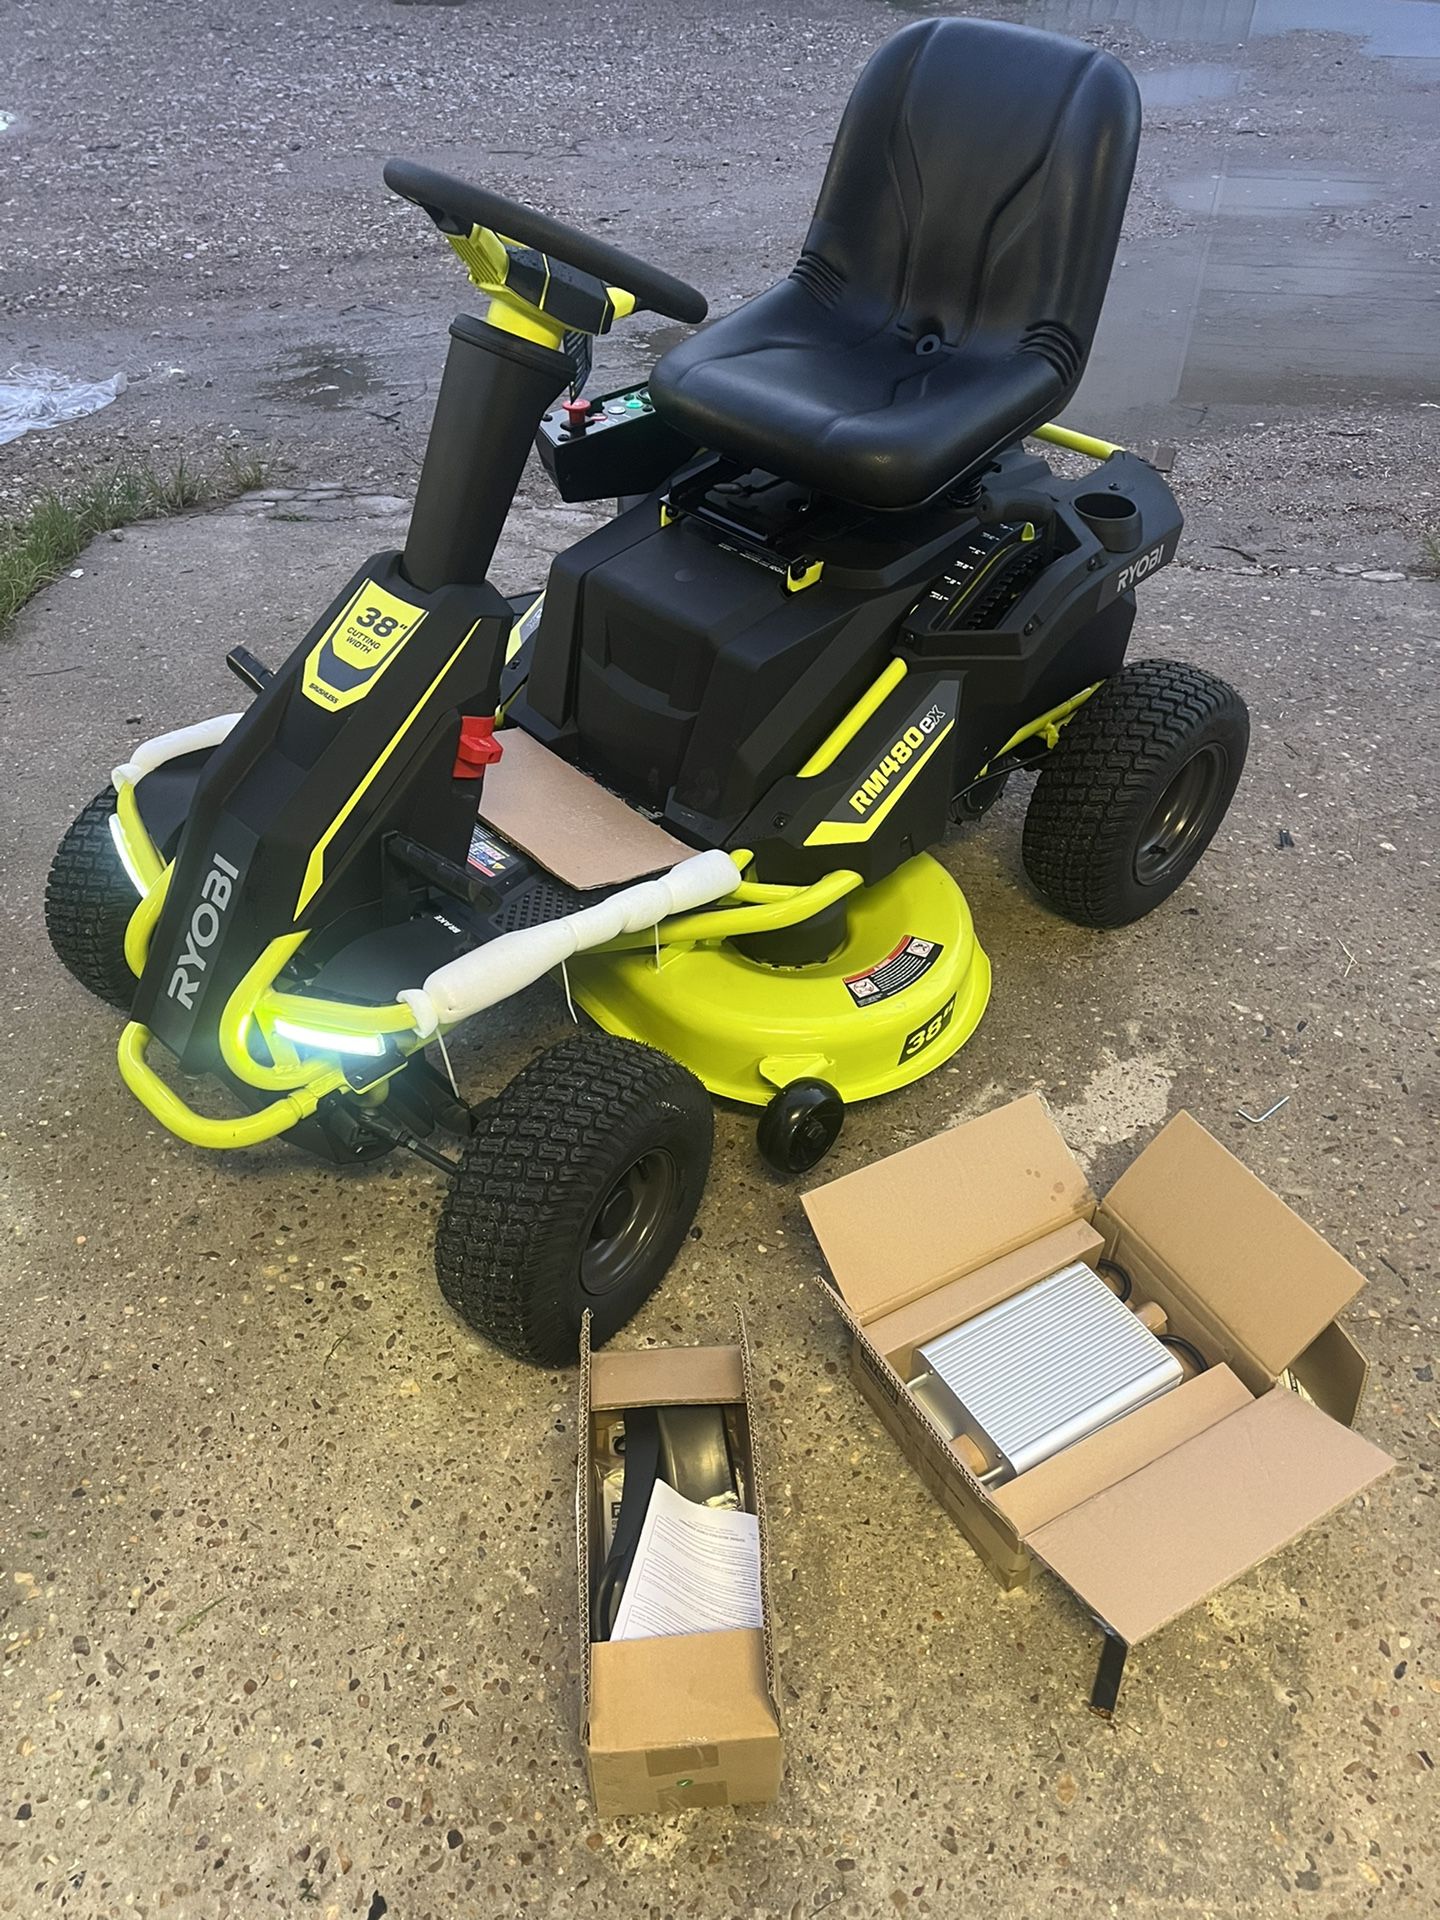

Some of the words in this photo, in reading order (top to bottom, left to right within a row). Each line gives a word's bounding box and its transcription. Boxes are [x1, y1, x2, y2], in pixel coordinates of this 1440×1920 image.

[1117, 544, 1164, 592] RYOBI
[356, 607, 408, 637] 38"
[346, 636, 372, 654] WIDTH
[347, 627, 381, 650] CUTTING
[308, 682, 339, 704] BRUSHLESS
[167, 853, 239, 1010] RYOBI
[906, 1000, 955, 1055] 38"
